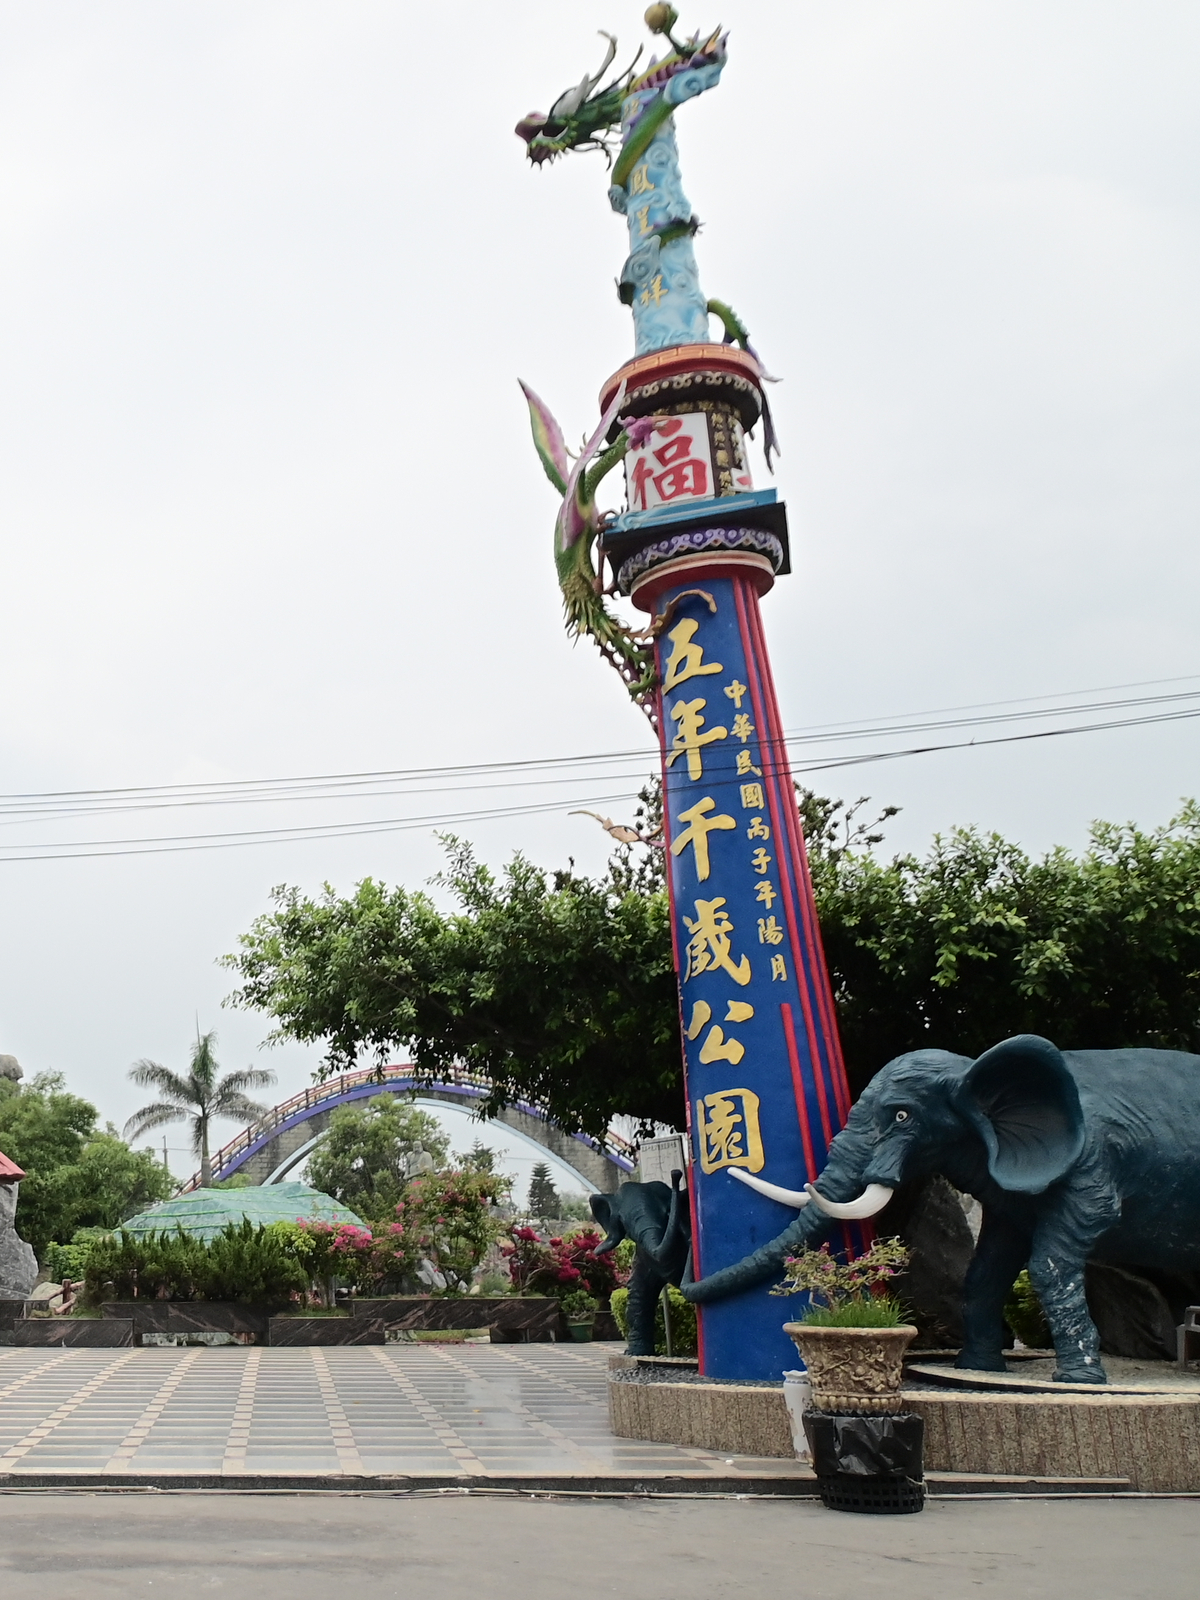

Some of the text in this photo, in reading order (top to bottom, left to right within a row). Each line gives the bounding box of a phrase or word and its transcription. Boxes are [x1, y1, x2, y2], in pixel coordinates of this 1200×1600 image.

[631, 417, 708, 510] 福
[662, 617, 765, 1175] 五年千歲公園
[724, 679, 787, 982] 中華民國丙子年陽月
